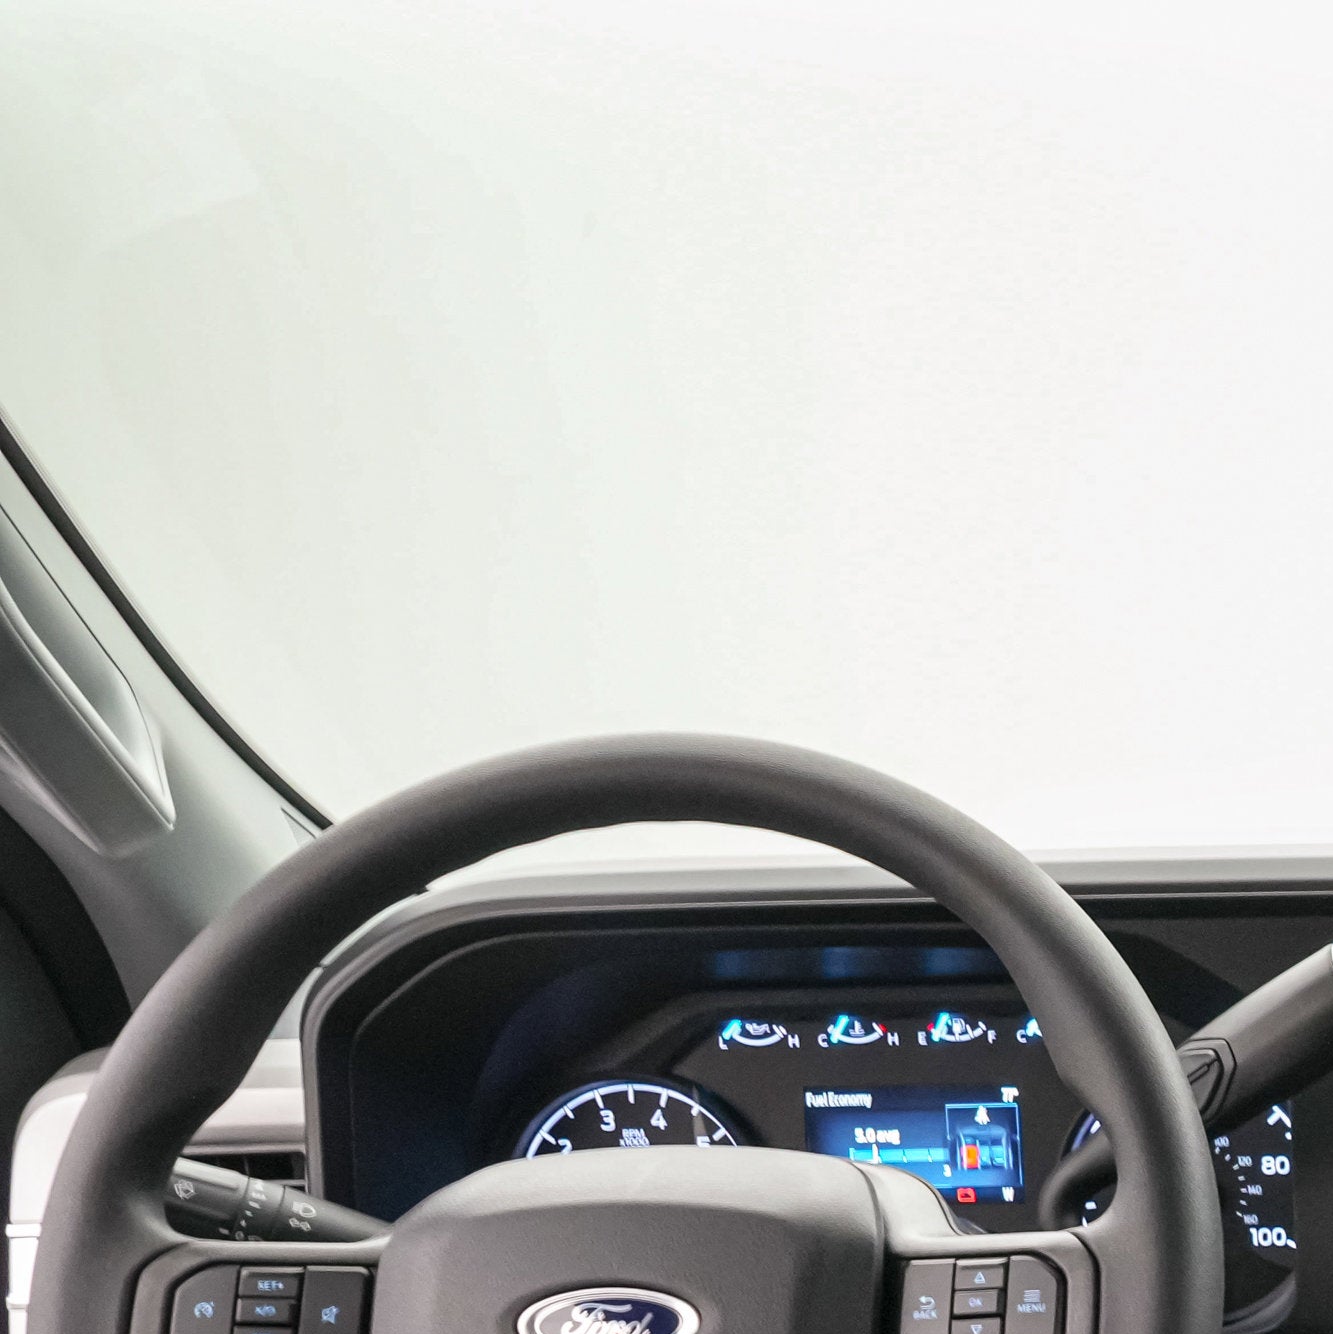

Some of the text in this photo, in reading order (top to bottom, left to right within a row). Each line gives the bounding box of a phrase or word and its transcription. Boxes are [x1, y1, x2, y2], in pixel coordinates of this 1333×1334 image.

[788, 1034, 800, 1048] H
[818, 1034, 829, 1047] C
[887, 1032, 899, 1046] H
[918, 1031, 928, 1046] E
[987, 1030, 997, 1044] F
[1016, 1030, 1026, 1043] C
[805, 1091, 872, 1109] Fuel Economy
[600, 1109, 616, 1132] 3
[650, 1109, 668, 1130] 4
[622, 1128, 645, 1138] RPM
[1237, 1156, 1252, 1167] 120
[1261, 1155, 1290, 1176] 80
[1247, 1185, 1263, 1196] 140
[1250, 1227, 1287, 1247] 100
[1017, 1303, 1046, 1313] MENU
[913, 1311, 938, 1320] BACK
